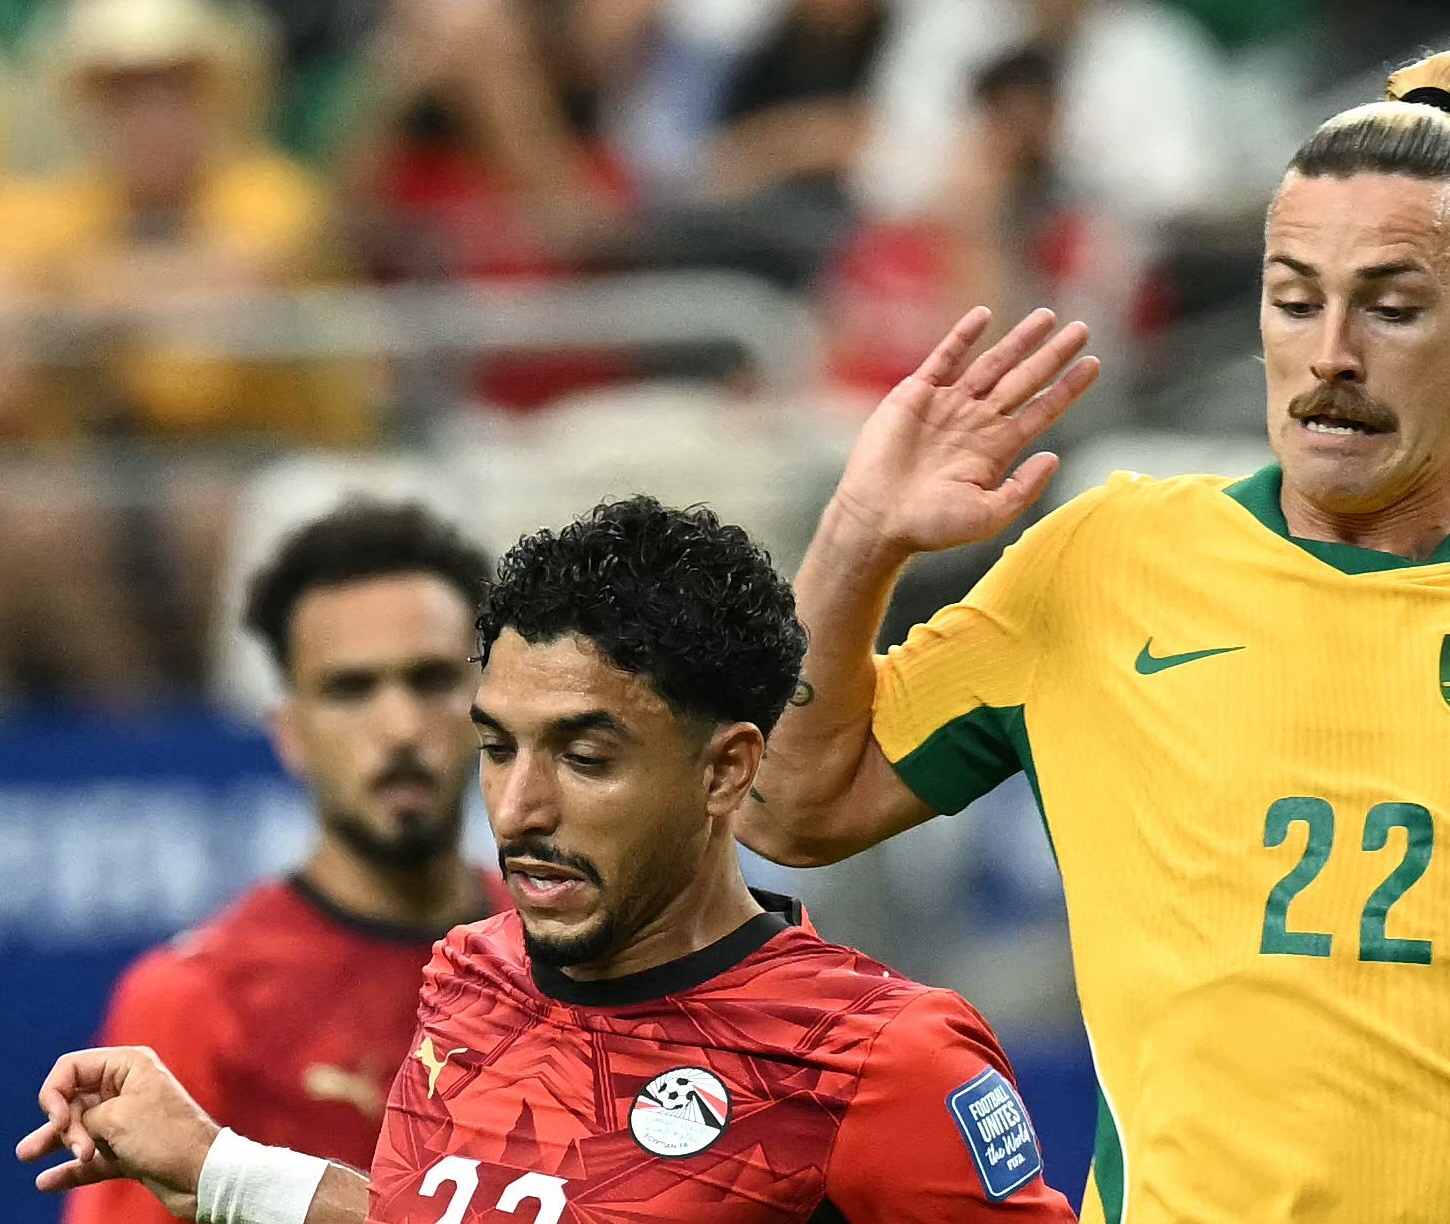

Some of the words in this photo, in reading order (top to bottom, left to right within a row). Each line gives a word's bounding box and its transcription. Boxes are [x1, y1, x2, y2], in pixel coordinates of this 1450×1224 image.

[1259, 796, 1434, 965] 22
[968, 1084, 1010, 1121] FOOTBALL
[976, 1100, 1021, 1143] UNITES
[984, 1143, 1005, 1166] the
[1003, 1121, 1032, 1155] World
[1006, 1153, 1026, 1171] FIFA
